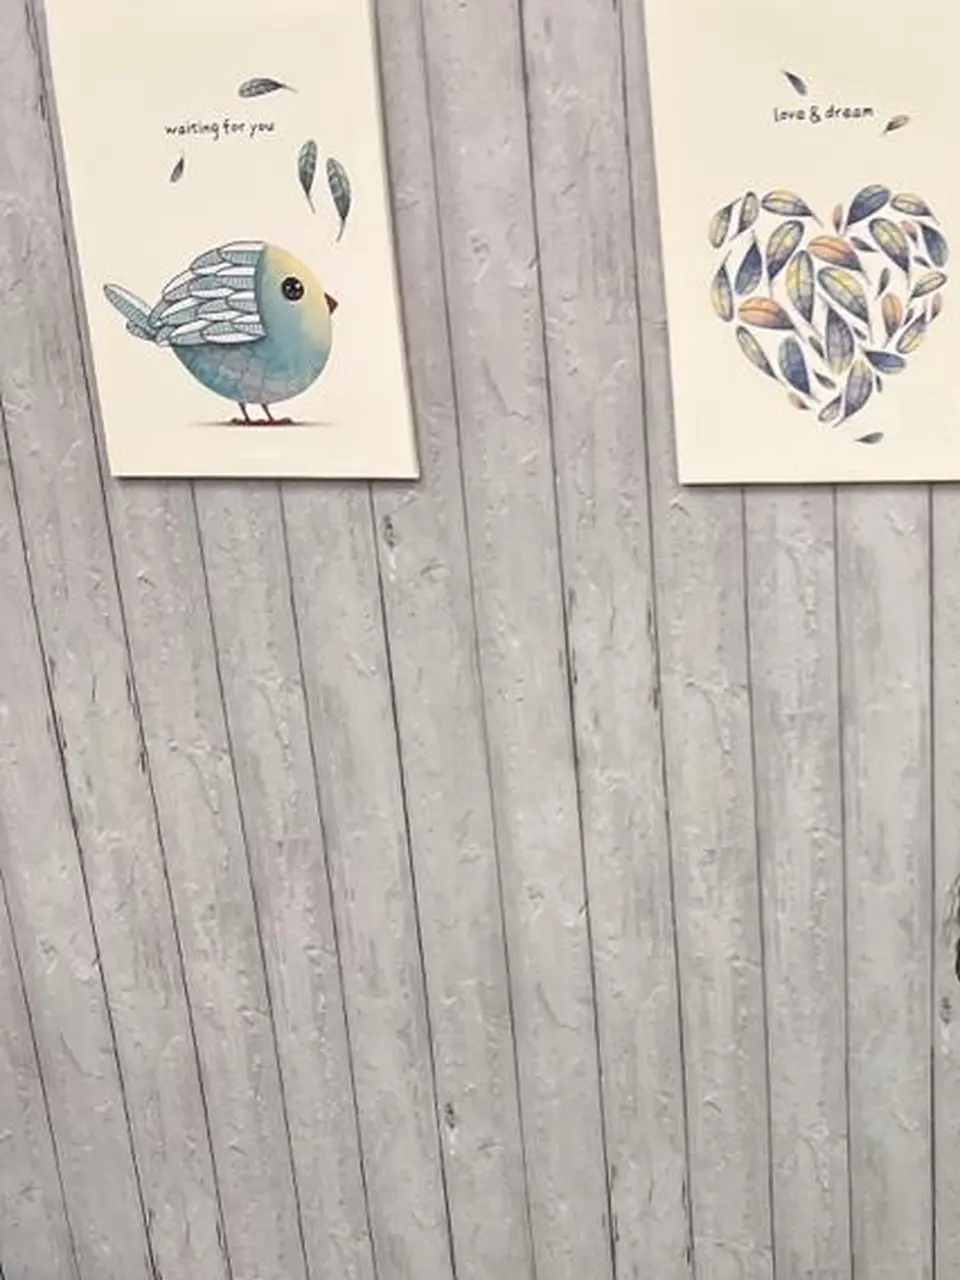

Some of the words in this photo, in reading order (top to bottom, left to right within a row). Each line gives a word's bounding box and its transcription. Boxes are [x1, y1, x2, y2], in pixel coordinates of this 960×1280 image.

[773, 107, 806, 122] love
[809, 105, 822, 123] &
[825, 104, 874, 119] dream
[164, 120, 219, 140] waiting
[223, 118, 246, 134] for
[249, 121, 275, 138] you
